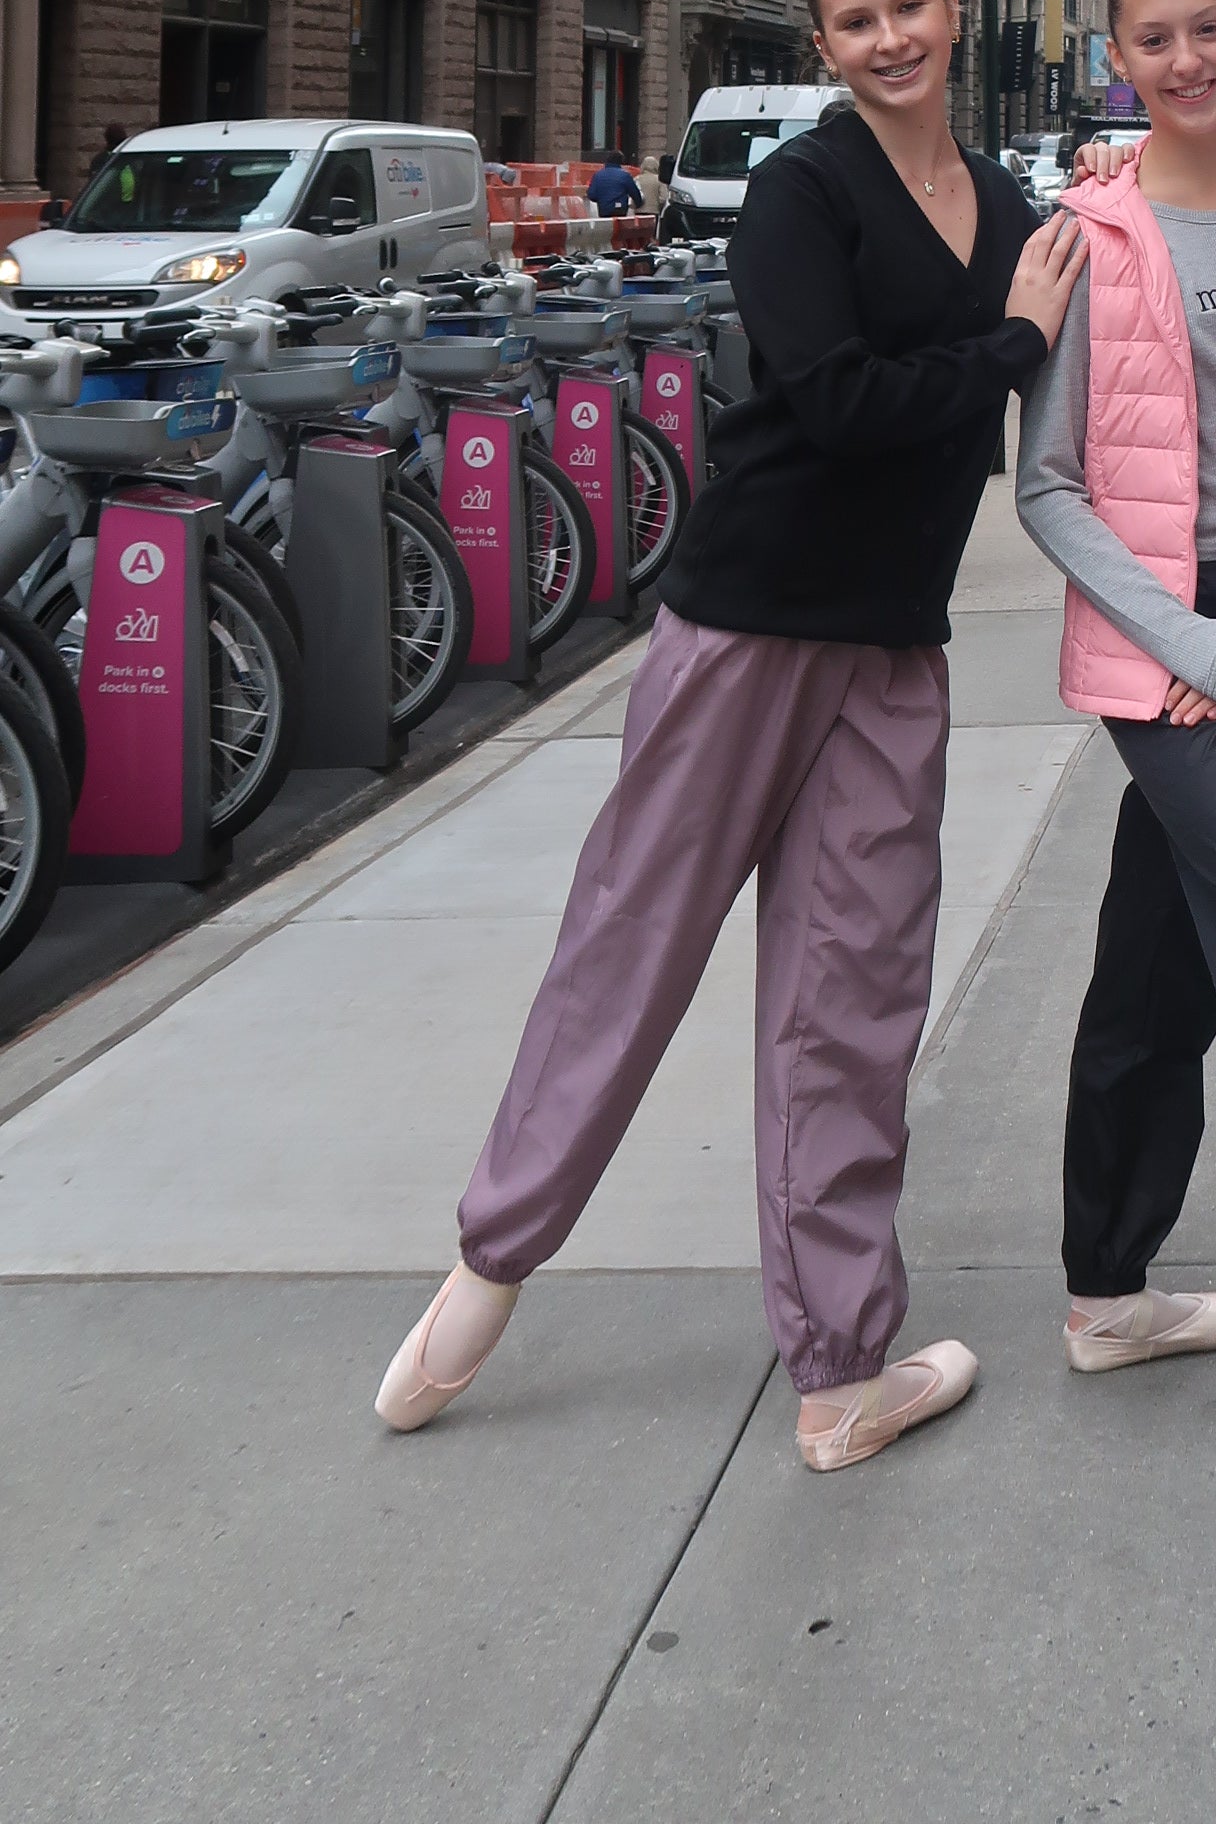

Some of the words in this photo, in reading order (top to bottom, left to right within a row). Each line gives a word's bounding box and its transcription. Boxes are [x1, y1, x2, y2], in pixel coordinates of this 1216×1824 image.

[1051, 68, 1059, 80] LV
[1050, 81, 1059, 112] WOOD
[661, 376, 676, 392] A
[577, 406, 593, 423] A
[469, 442, 488, 461] A
[453, 526, 474, 535] Park
[476, 526, 485, 535] in
[455, 539, 476, 547] ocks
[479, 538, 499, 548] first.
[127, 548, 155, 575] A
[103, 664, 134, 678] Park
[136, 665, 149, 678] in
[98, 681, 137, 694] docks
[140, 681, 169, 695] first.
